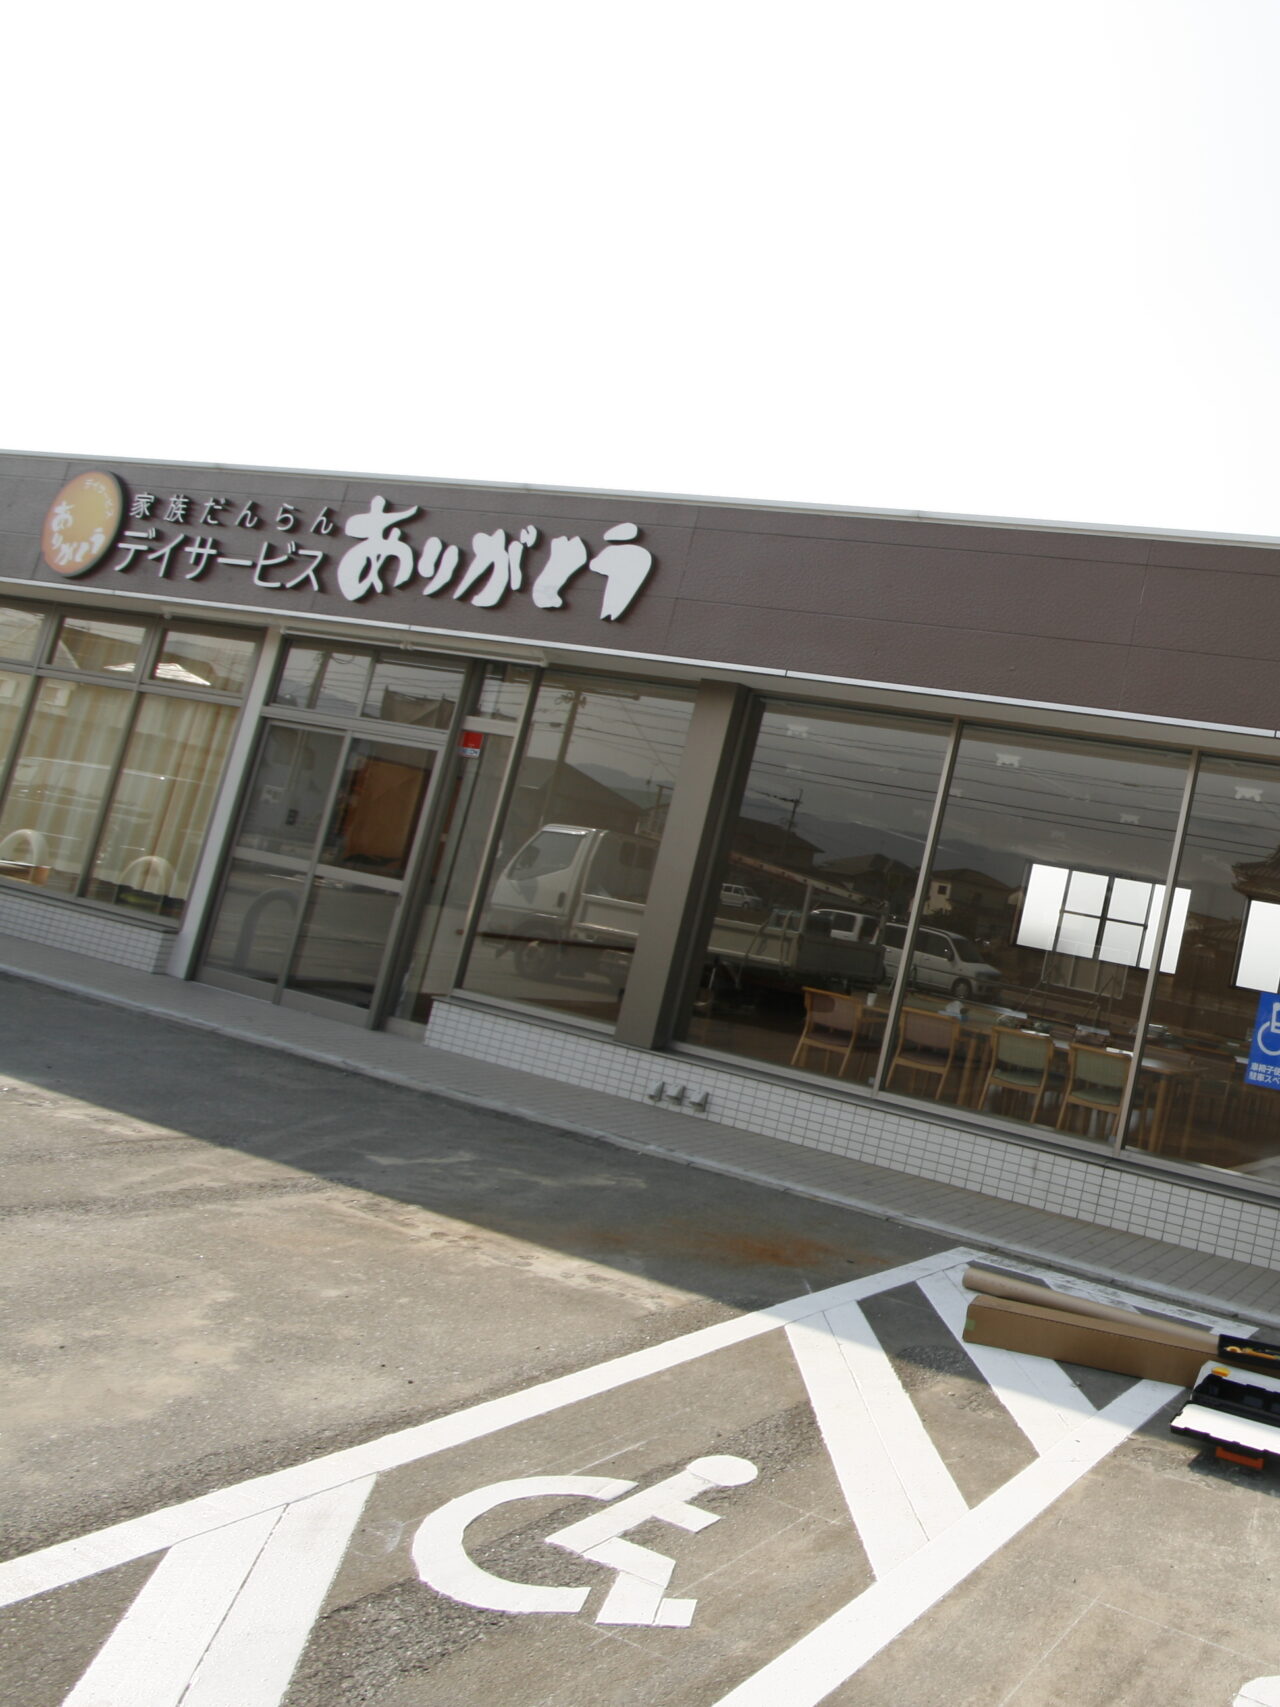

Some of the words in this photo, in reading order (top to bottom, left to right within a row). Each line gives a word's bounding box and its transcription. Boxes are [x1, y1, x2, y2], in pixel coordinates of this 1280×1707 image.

[51, 500, 106, 566] ありがとう
[129, 492, 333, 536] 家族だんらん
[114, 529, 327, 593] デイサービス
[336, 494, 653, 621] ありがとう
